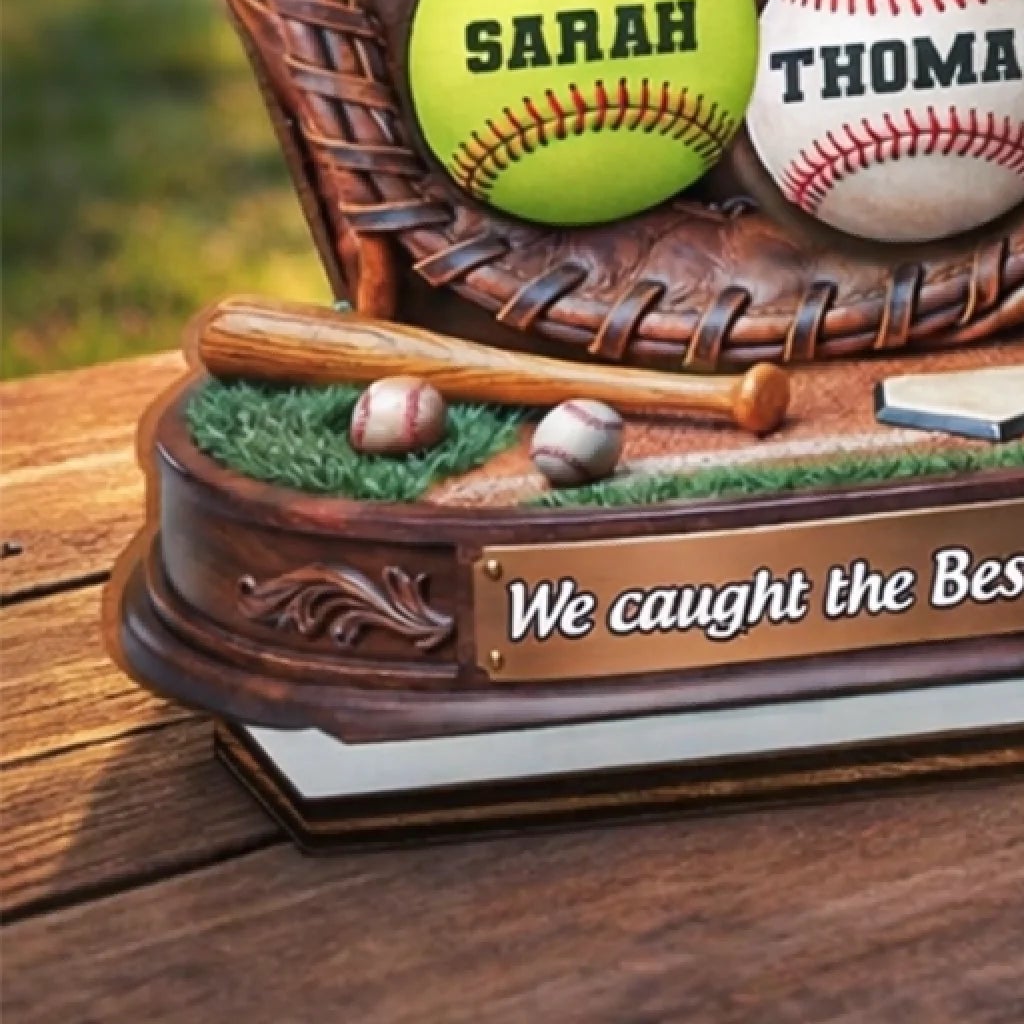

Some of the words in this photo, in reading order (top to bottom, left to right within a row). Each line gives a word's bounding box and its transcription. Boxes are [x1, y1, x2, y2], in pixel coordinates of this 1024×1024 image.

[508, 578, 596, 641] We
[608, 568, 811, 639] caught
[824, 560, 915, 618] the
